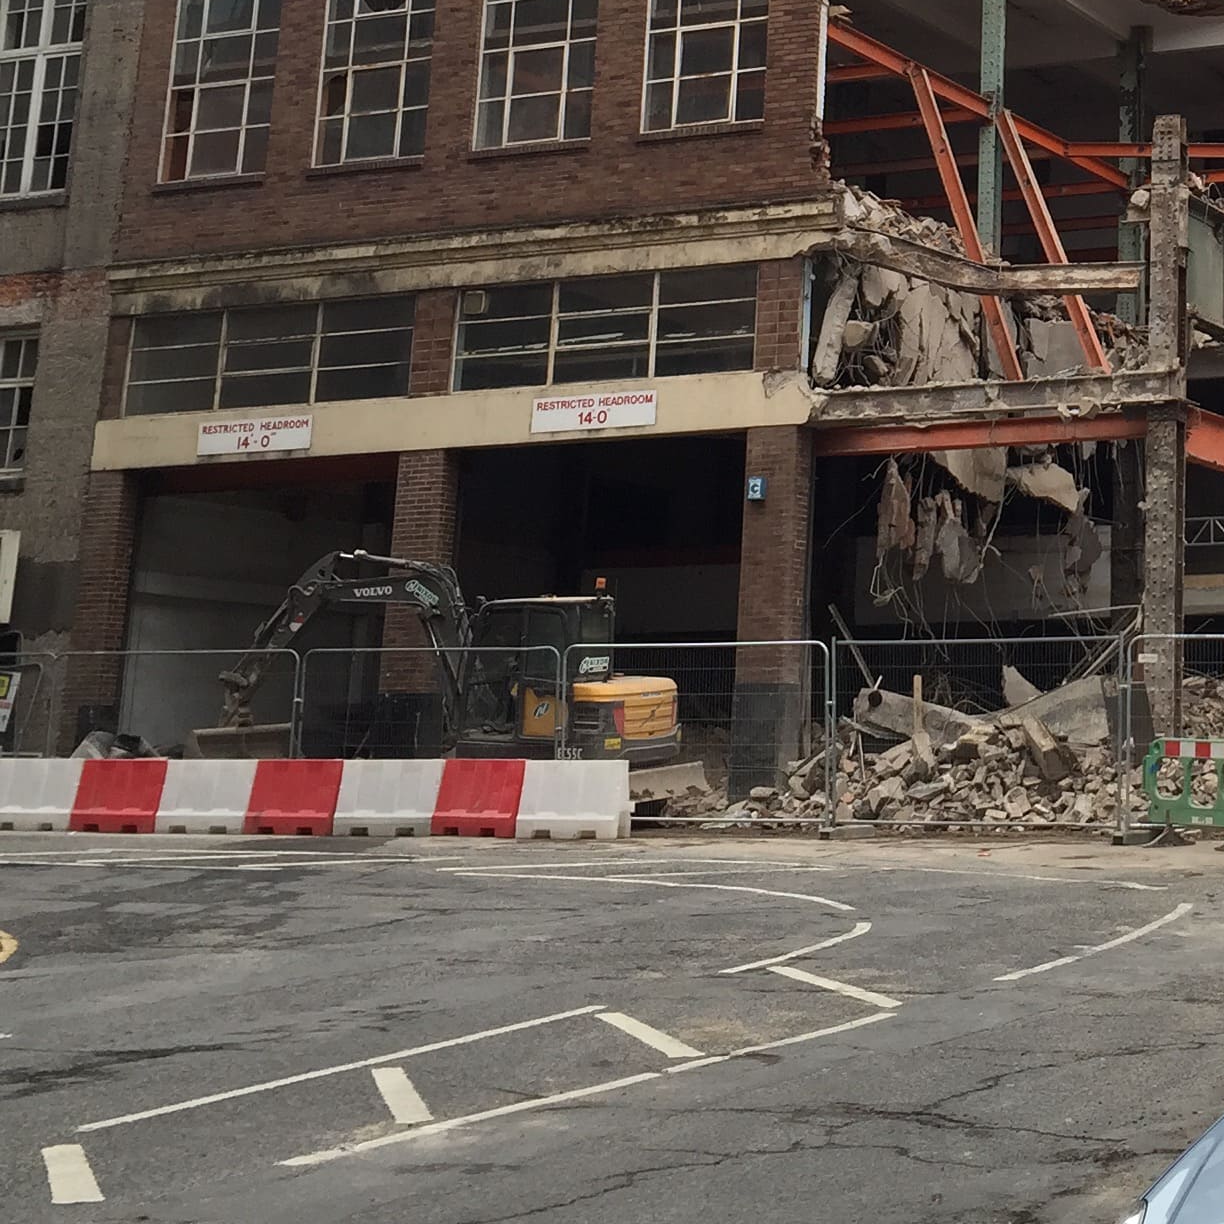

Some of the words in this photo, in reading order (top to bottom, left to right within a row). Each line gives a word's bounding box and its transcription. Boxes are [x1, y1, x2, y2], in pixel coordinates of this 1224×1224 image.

[536, 398, 595, 411] RESTRICTED
[598, 394, 653, 407] HEADROOM
[202, 423, 255, 435] RESTRICTED
[260, 419, 309, 431] HEADROOM
[353, 585, 393, 597] VOLVO
